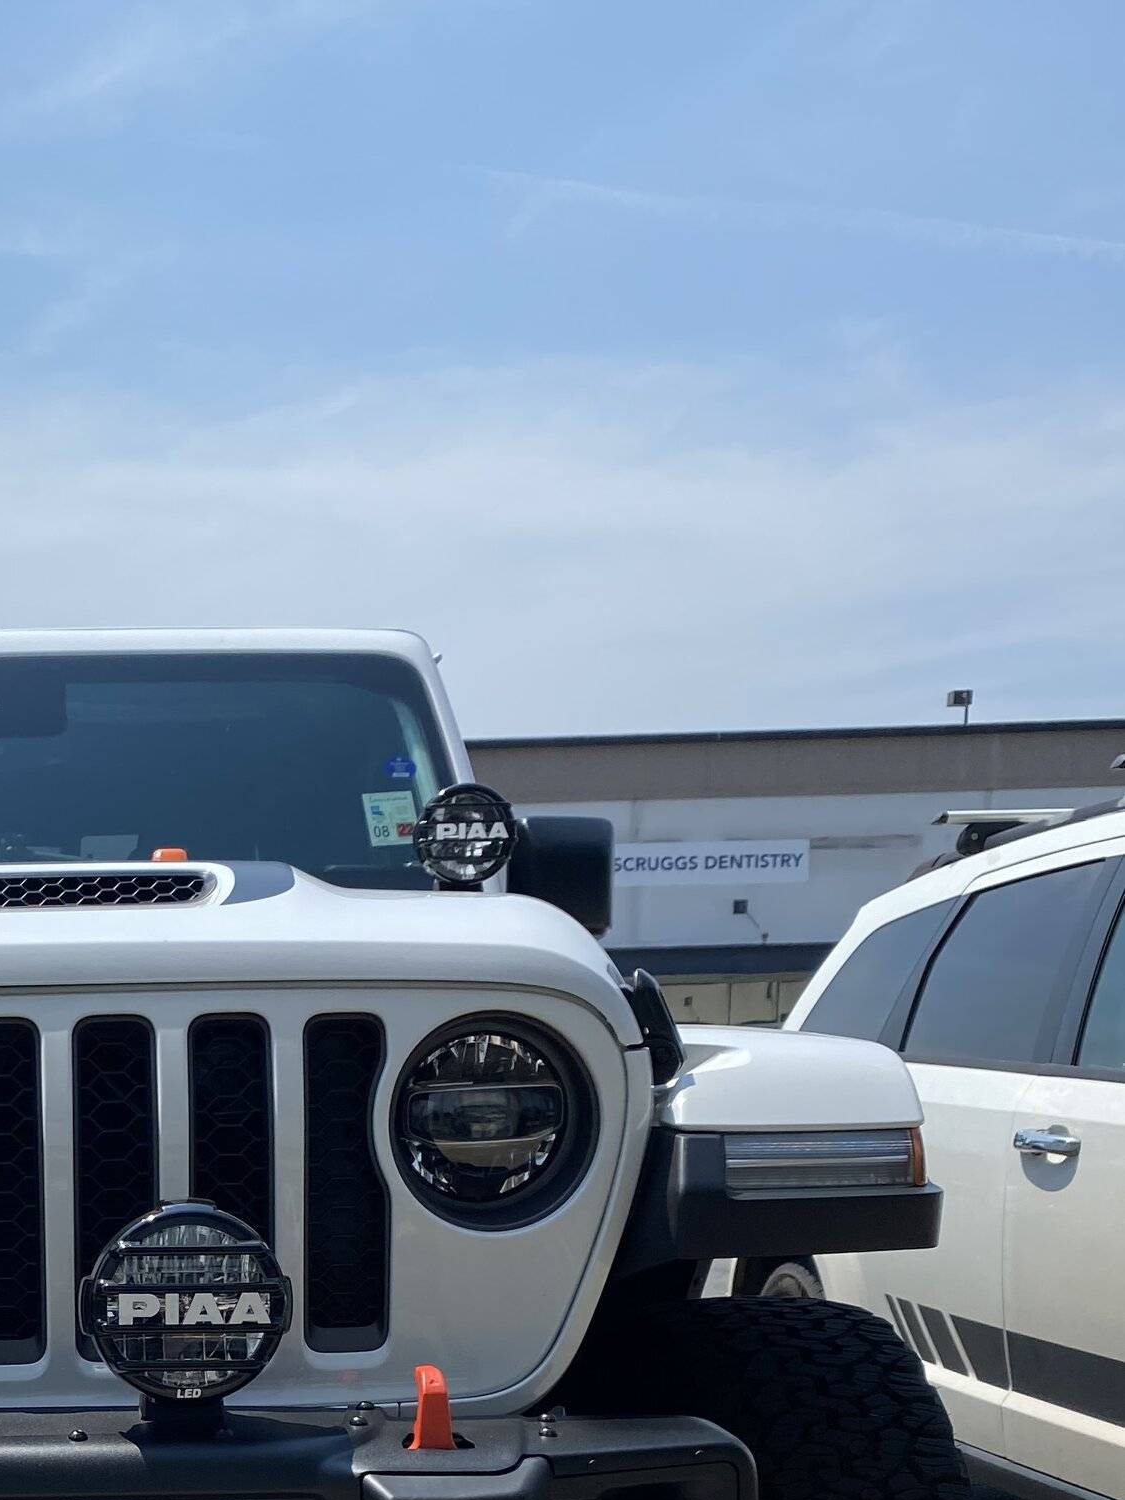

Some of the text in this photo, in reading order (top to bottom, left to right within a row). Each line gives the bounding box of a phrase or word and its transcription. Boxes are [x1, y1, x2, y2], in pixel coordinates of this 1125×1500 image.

[374, 825, 390, 838] 08
[437, 822, 509, 840] PIAA
[614, 853, 804, 872] SCRUGGS DENTISTRY
[118, 1292, 272, 1326] PIAA
[177, 1389, 202, 1399] LED
